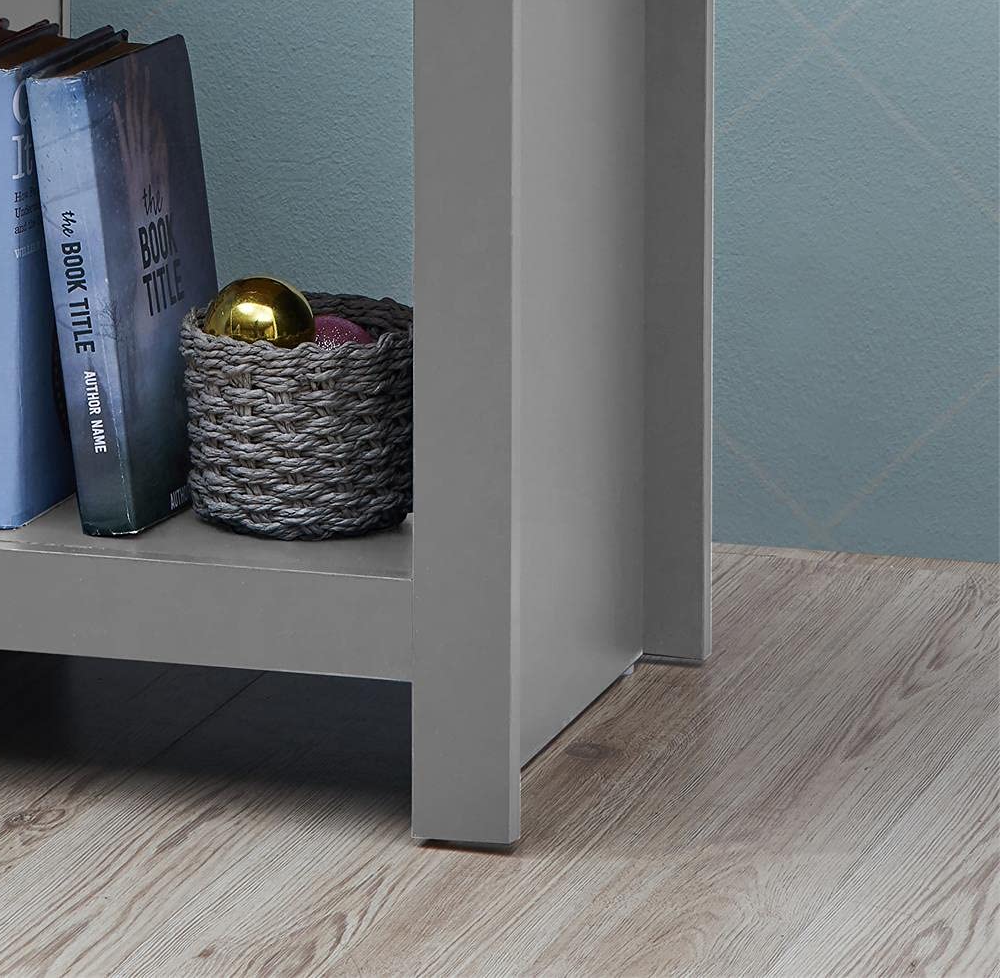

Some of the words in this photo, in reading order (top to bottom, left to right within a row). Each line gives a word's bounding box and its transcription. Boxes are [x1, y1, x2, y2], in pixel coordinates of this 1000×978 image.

[142, 182, 163, 215] the
[61, 210, 77, 237] the
[138, 213, 178, 270] BOOK
[61, 241, 88, 294] BOOK
[142, 259, 185, 317] TITLE
[69, 297, 96, 354] TITLE
[83, 371, 102, 415] AUTHOR
[90, 419, 107, 454] NAME
